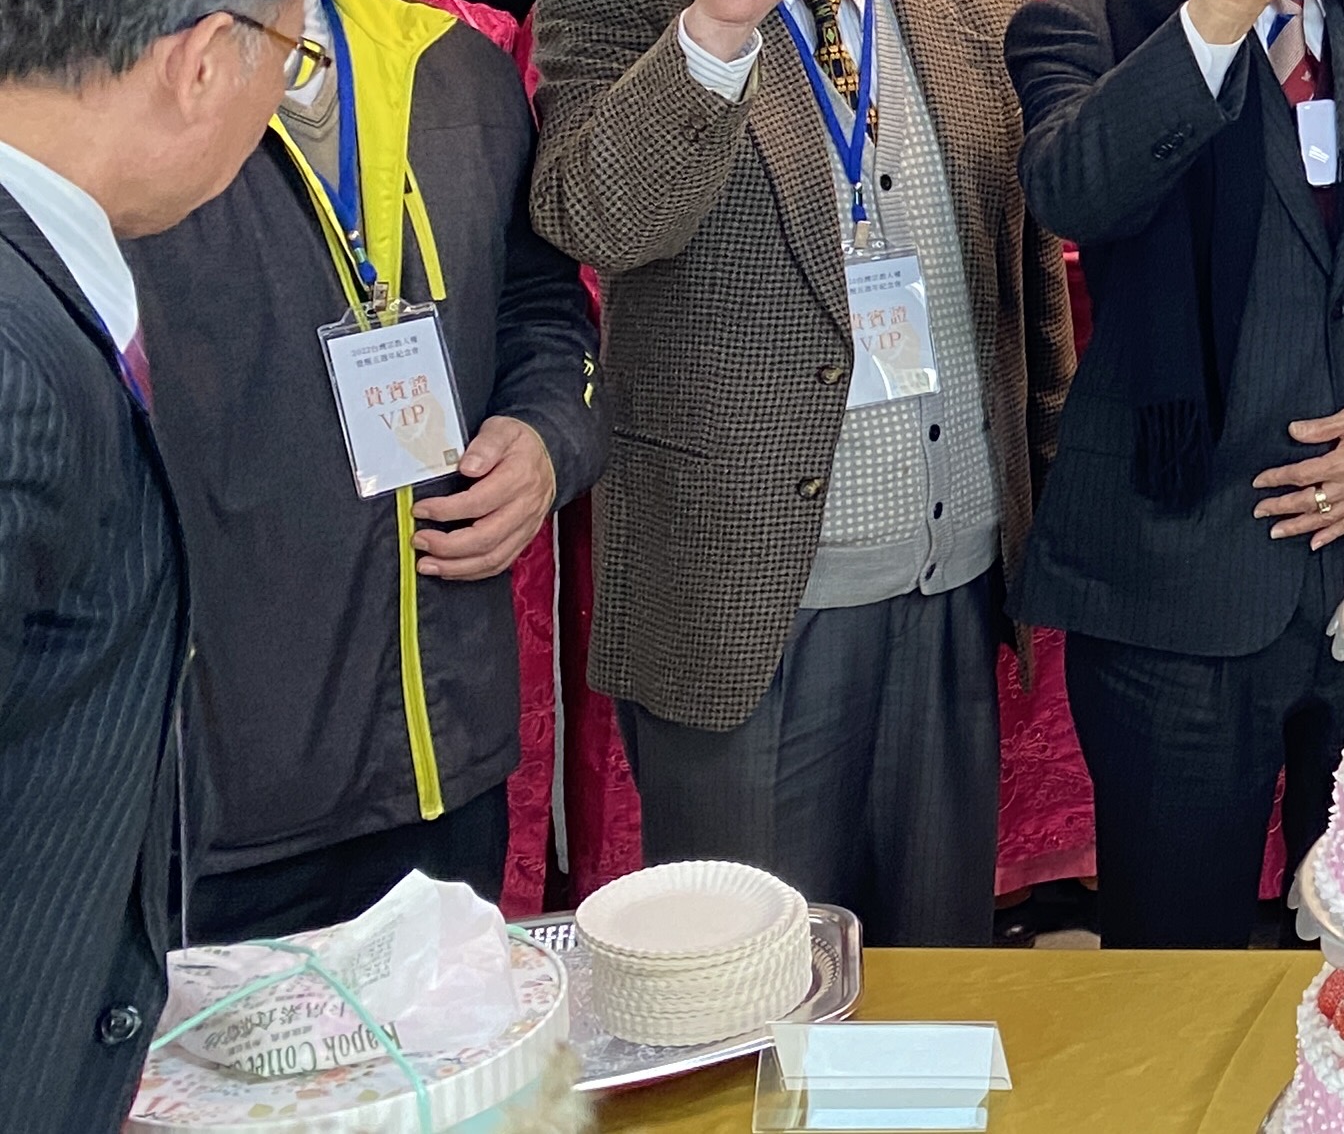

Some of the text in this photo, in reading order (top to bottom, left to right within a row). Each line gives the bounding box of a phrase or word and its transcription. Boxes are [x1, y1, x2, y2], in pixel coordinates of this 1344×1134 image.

[860, 331, 902, 352] VIP
[363, 374, 431, 409] 貴賓證
[379, 404, 425, 430] VIP
